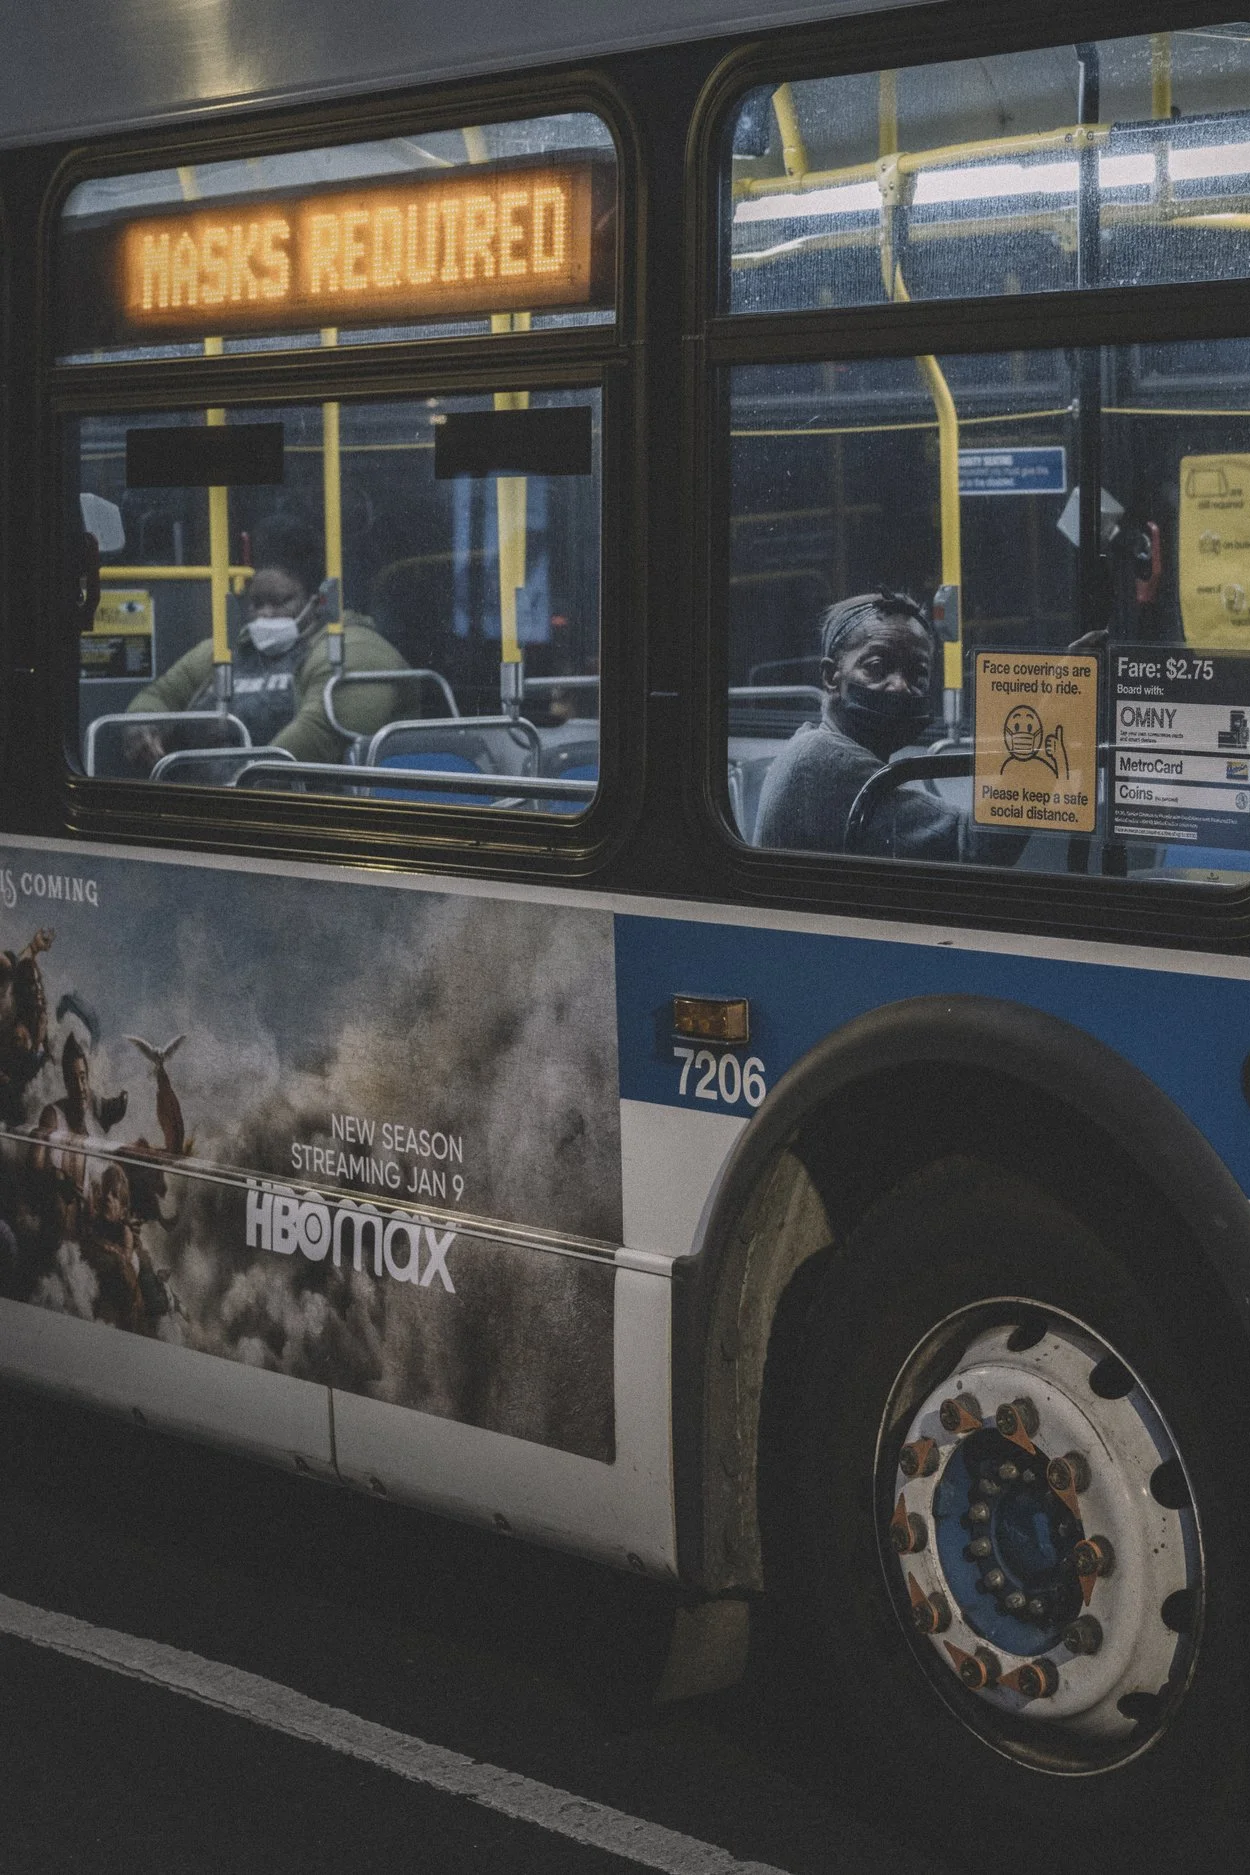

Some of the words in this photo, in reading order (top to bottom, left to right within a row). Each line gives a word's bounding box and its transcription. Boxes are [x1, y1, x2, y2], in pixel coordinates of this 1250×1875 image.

[142, 218, 291, 310] MASKS
[309, 186, 567, 293] REQUIRED
[983, 660, 1010, 674] Face
[1013, 663, 1069, 679] coverings
[1072, 666, 1091, 678] are
[1117, 656, 1161, 678] Fare:
[1166, 656, 1214, 681] $2.75
[991, 679, 1038, 695] required
[1041, 682, 1053, 693] to
[1055, 681, 1082, 695] ride.
[1117, 684, 1142, 695] Board
[1144, 685, 1165, 696] with:
[1120, 706, 1177, 729] OMNY
[1119, 757, 1183, 775] MetroCard
[982, 785, 1019, 801] Please
[1022, 788, 1051, 806] keep
[1053, 794, 1060, 804] a
[1064, 792, 1088, 806] safe
[1119, 784, 1153, 801] Coins
[990, 805, 1023, 819] social
[1027, 807, 1079, 823] distance.
[21, 872, 99, 907] COMING
[673, 1046, 767, 1108] 7206
[331, 1113, 376, 1146] NEW
[382, 1122, 463, 1164] SEASON
[291, 1142, 400, 1189] STREAMING
[407, 1166, 446, 1199] JAN
[452, 1174, 465, 1201] 9
